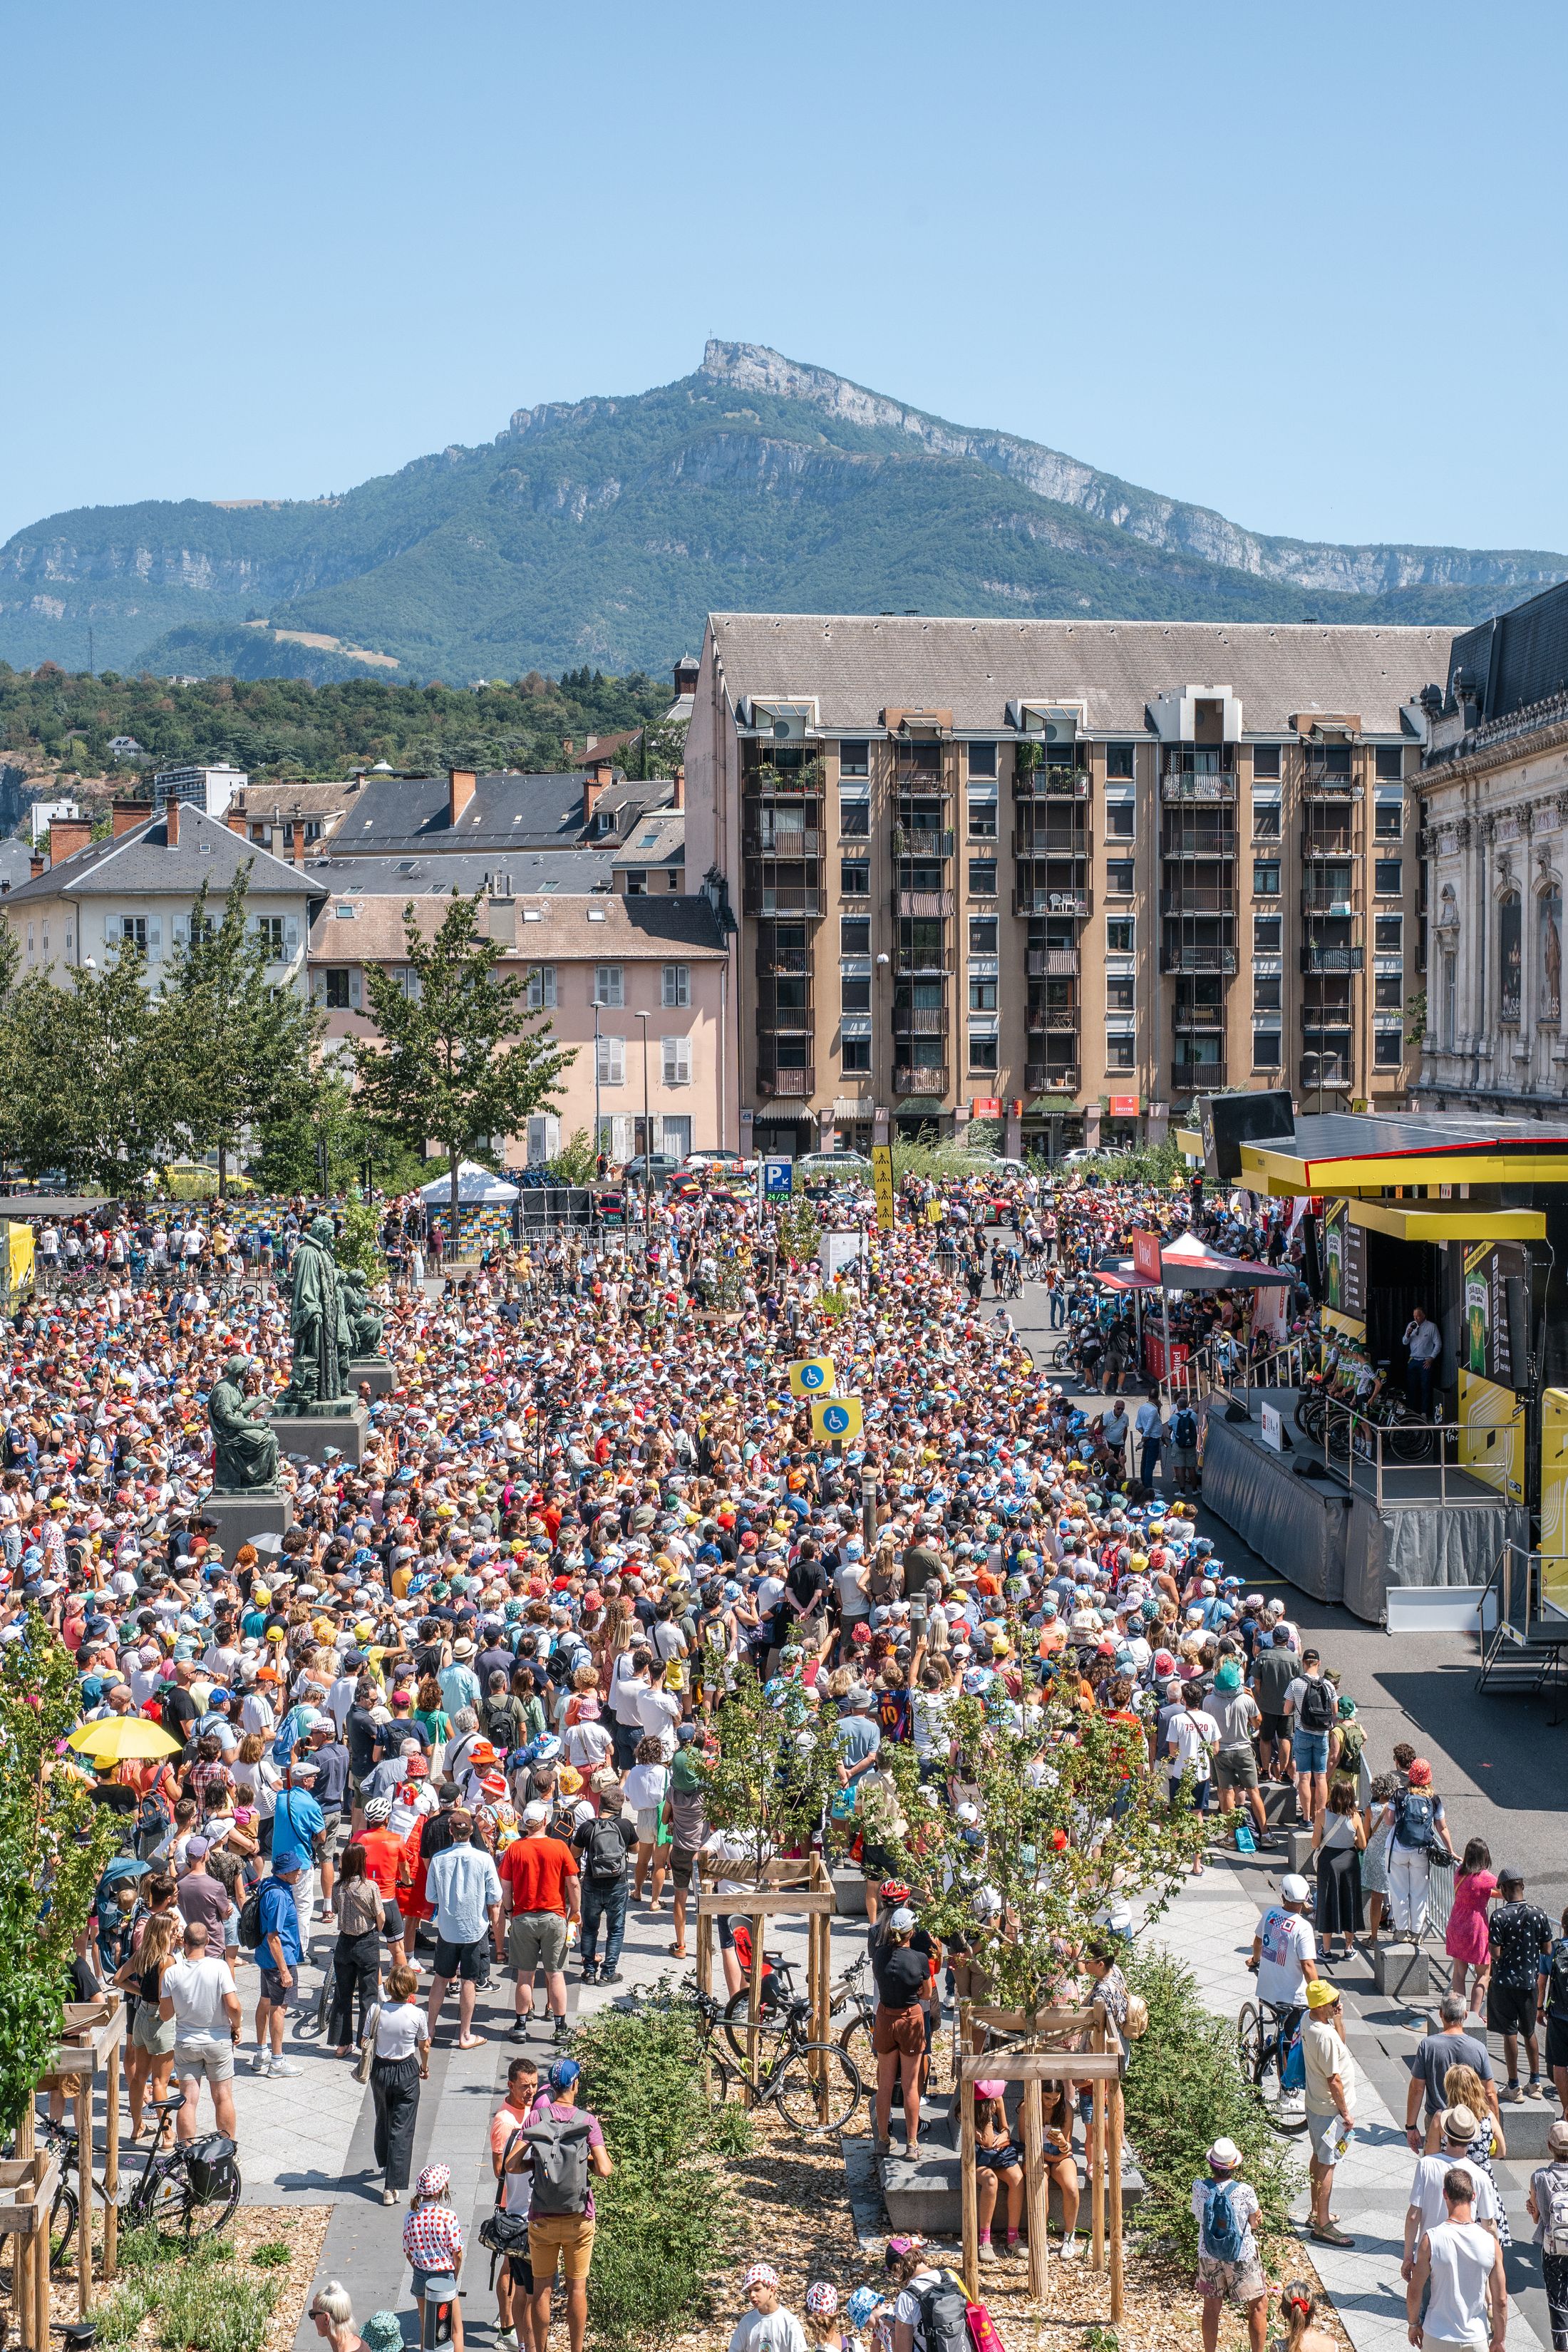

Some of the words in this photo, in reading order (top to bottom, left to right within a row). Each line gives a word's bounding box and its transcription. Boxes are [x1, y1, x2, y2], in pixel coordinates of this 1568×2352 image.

[1547, 992, 1559, 1015] des
[768, 1166, 782, 1184] P
[1138, 1239, 1152, 1267] Vittel
[881, 1706, 897, 1725] 10
